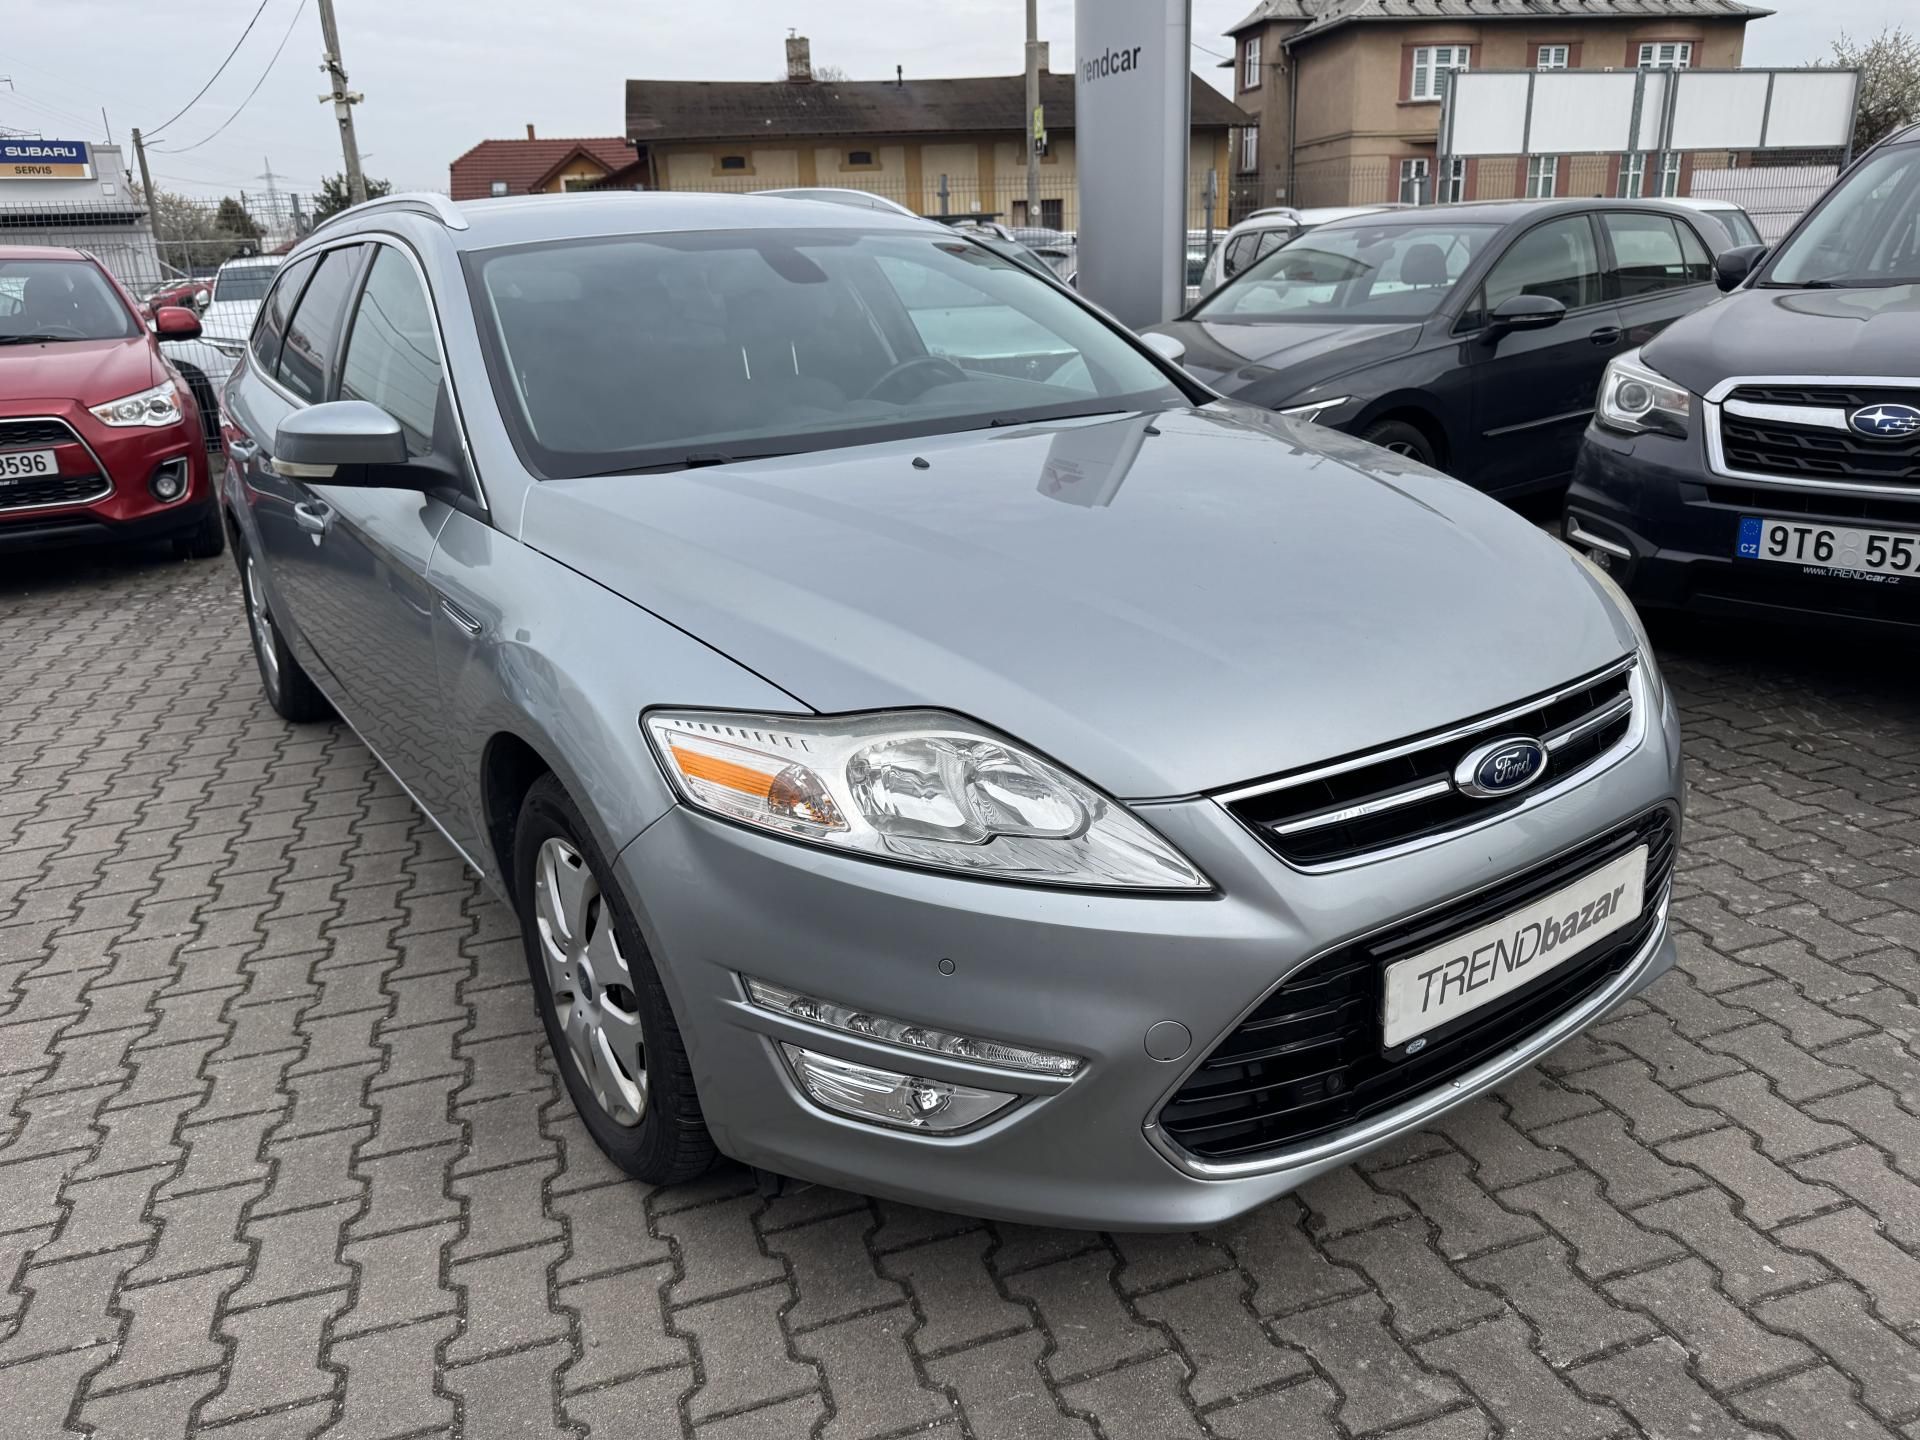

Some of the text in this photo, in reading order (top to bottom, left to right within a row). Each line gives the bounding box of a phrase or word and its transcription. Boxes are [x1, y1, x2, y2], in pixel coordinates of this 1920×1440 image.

[4, 146, 77, 157] SUBARU
[14, 166, 53, 175] SERVIS
[1740, 543, 1757, 554] CZ
[1768, 525, 1836, 562] 9T6
[1803, 565, 1900, 585] www.TRENDcar.cz
[1494, 751, 1532, 784] Ford
[1417, 883, 1625, 1012] TRENDbazar
